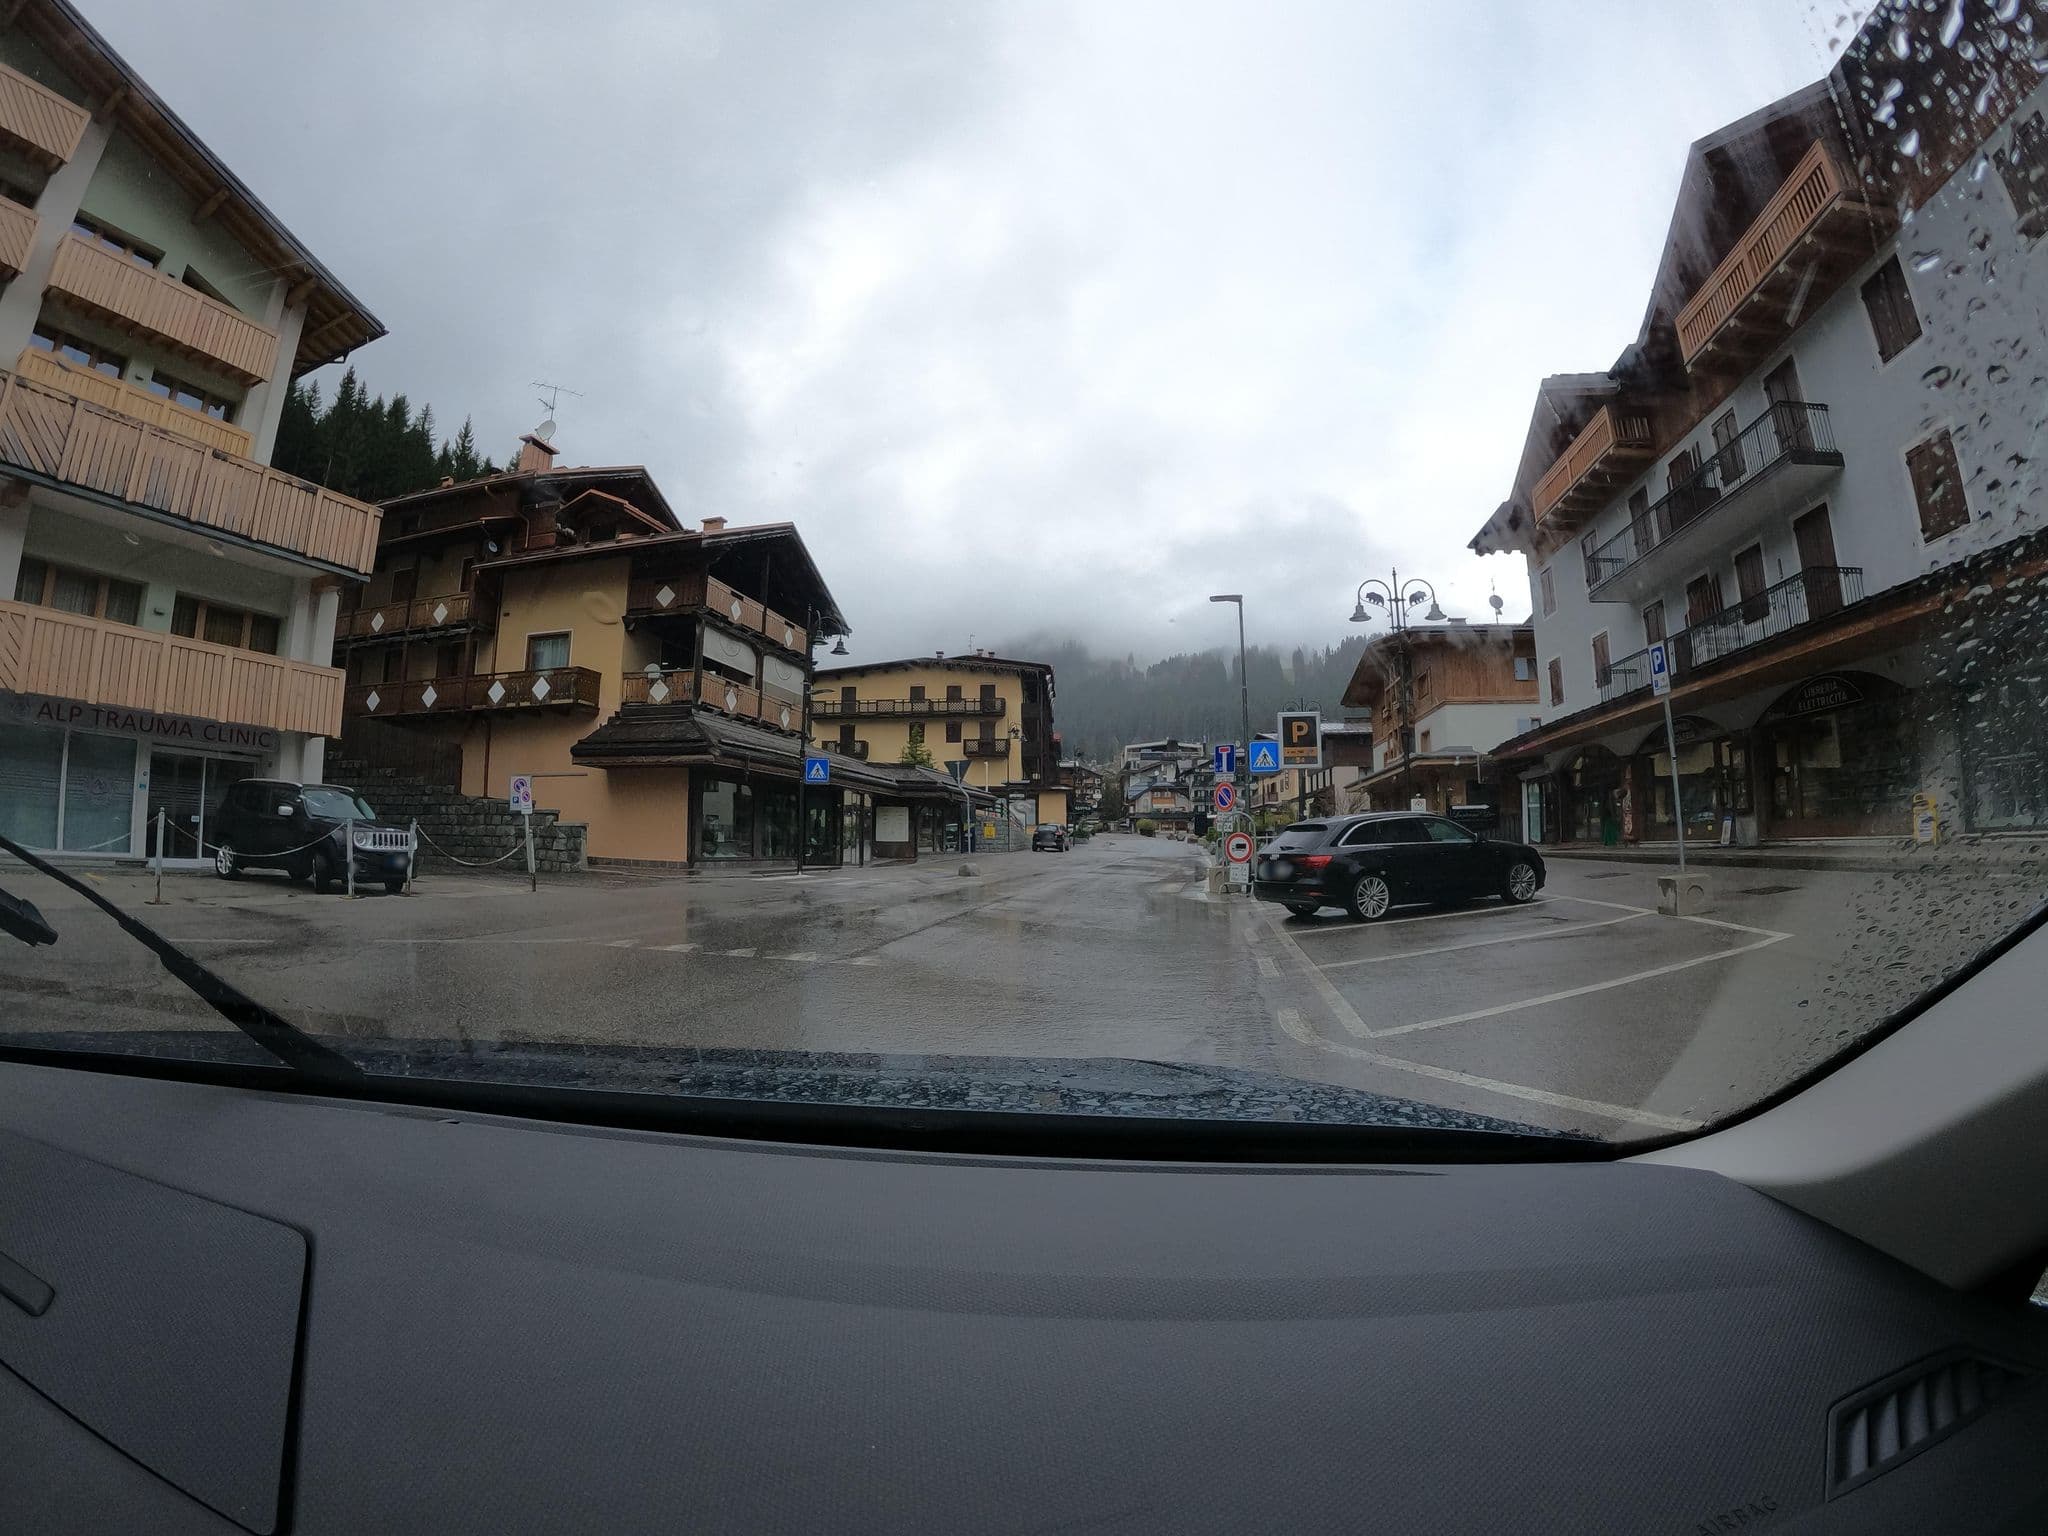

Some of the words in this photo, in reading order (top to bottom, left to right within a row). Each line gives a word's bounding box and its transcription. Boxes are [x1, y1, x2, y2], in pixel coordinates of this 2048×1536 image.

[1653, 650, 1661, 671] P
[37, 701, 83, 723] ALP
[90, 707, 193, 738] TRAUMA
[203, 724, 271, 748] CLINIC
[1292, 721, 1308, 743] P
[1697, 1495, 1776, 1536] AIRBAG
